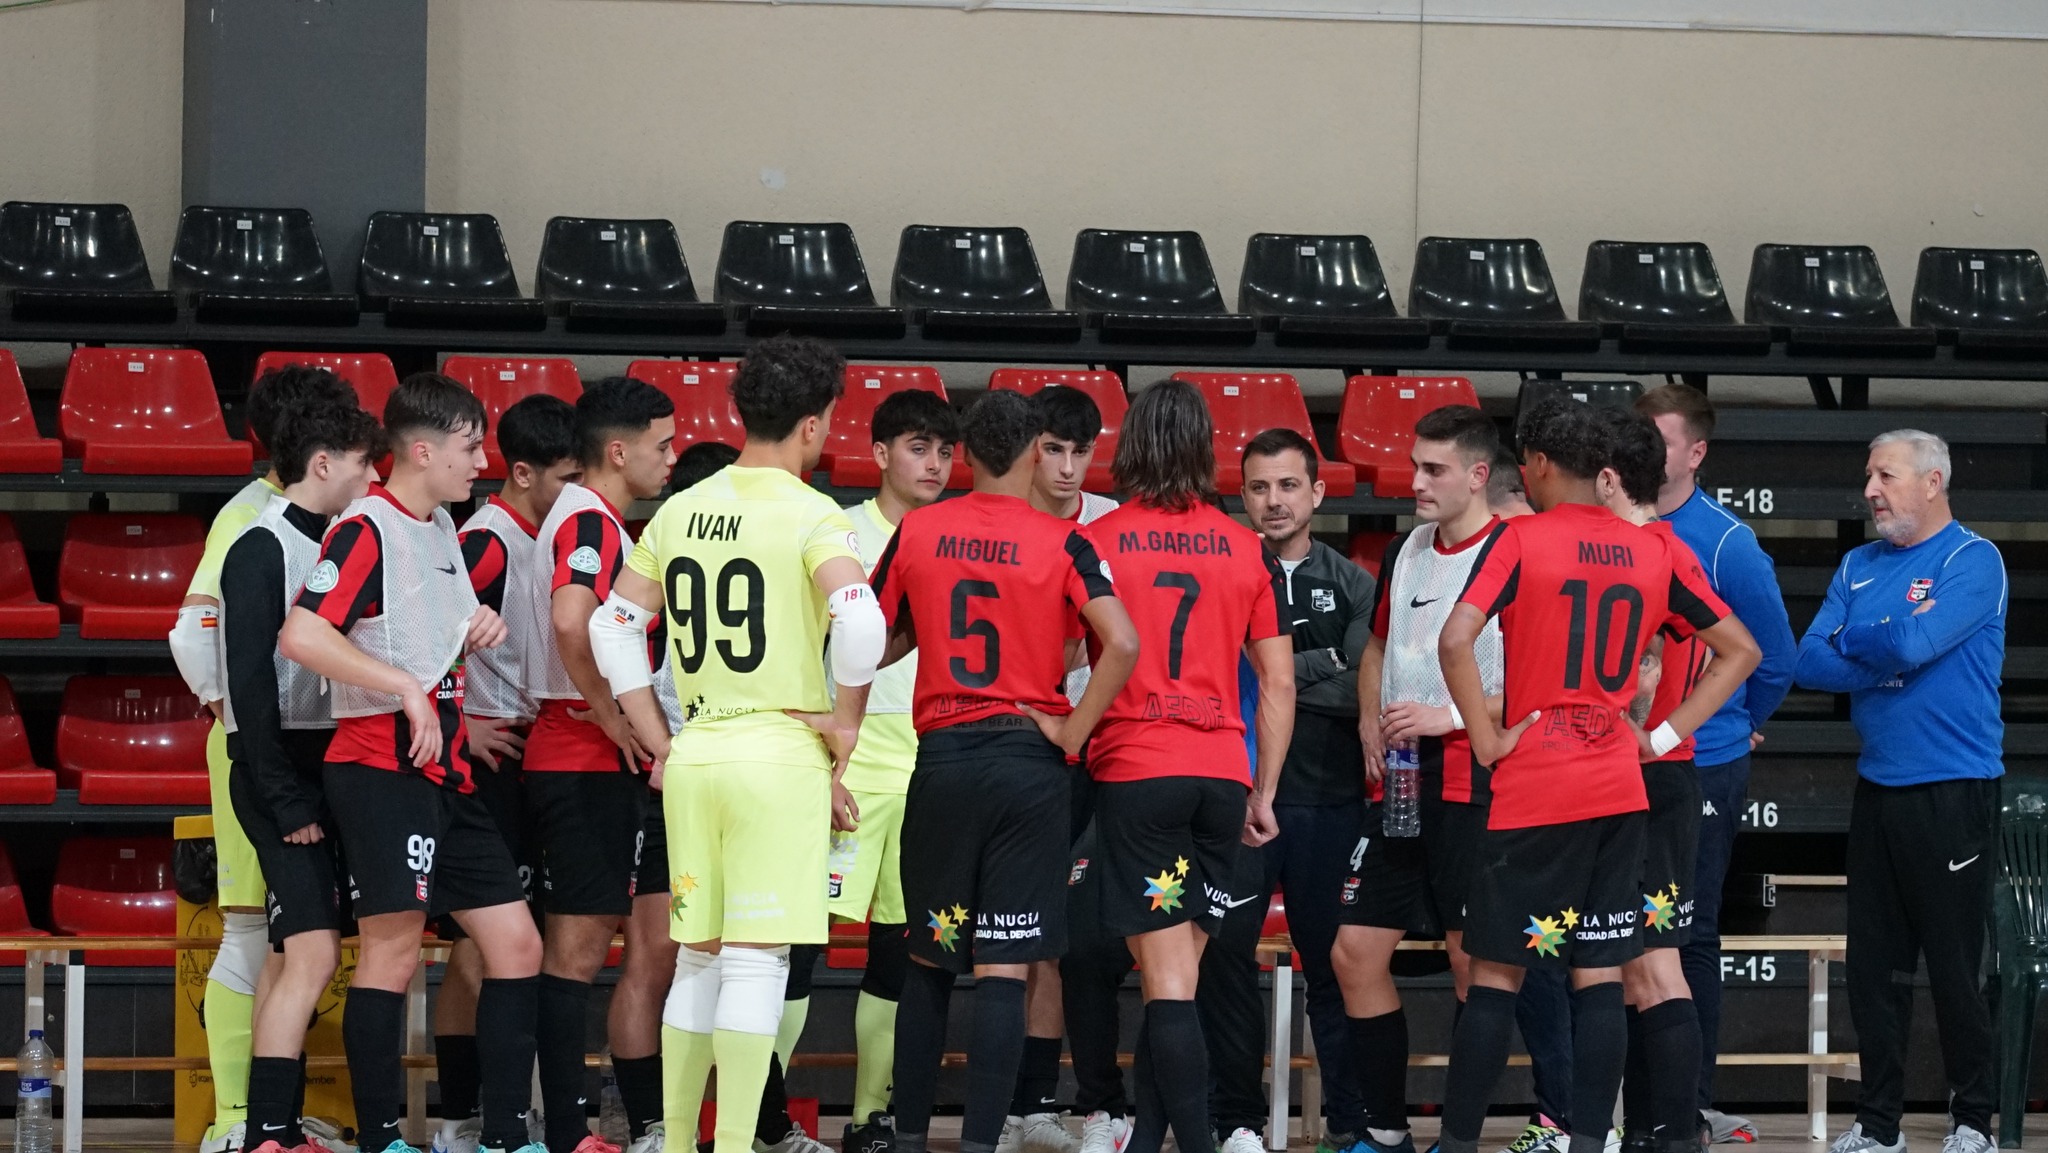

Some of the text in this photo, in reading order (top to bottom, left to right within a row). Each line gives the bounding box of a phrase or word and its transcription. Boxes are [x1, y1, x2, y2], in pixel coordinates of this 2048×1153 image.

[1717, 488, 1774, 514] F-18
[686, 512, 742, 541] IVAN
[935, 535, 1021, 566] MIGUEL
[1119, 529, 1232, 558] M.GARCÍA
[1578, 541, 1634, 568] MURI
[665, 556, 766, 674] 99
[1153, 571, 1201, 680] 7
[949, 579, 1000, 689] 5
[1559, 579, 1644, 693] 10
[441, 677, 453, 689] LA
[407, 834, 435, 874] 98
[1349, 836, 1370, 872] 4
[977, 912, 989, 926] LA
[1583, 910, 1638, 927] LA NUCÍ
[1576, 931, 1607, 940] CIUDAD
[1720, 956, 1776, 982] F-15
